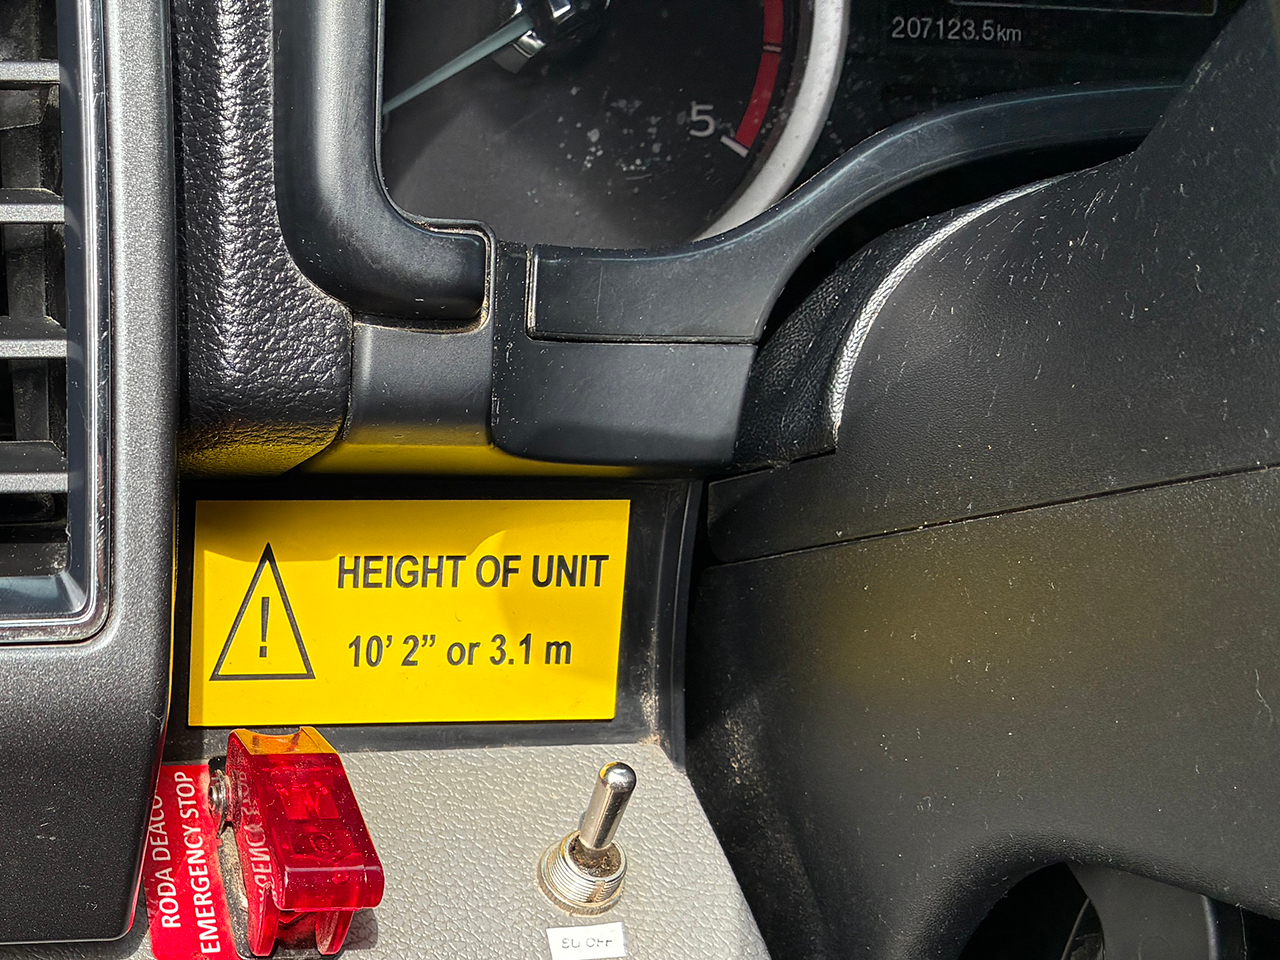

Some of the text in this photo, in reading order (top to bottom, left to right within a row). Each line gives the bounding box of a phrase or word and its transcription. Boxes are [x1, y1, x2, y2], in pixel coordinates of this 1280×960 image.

[688, 104, 717, 138] 5
[337, 554, 610, 590] HEIGHT OF UNIT
[348, 634, 394, 668] 10’
[447, 641, 481, 667] or
[489, 633, 532, 666] 3.1
[545, 638, 573, 665] m
[174, 771, 221, 954] EMERGENCY STOP
[154, 867, 181, 928] RODA
